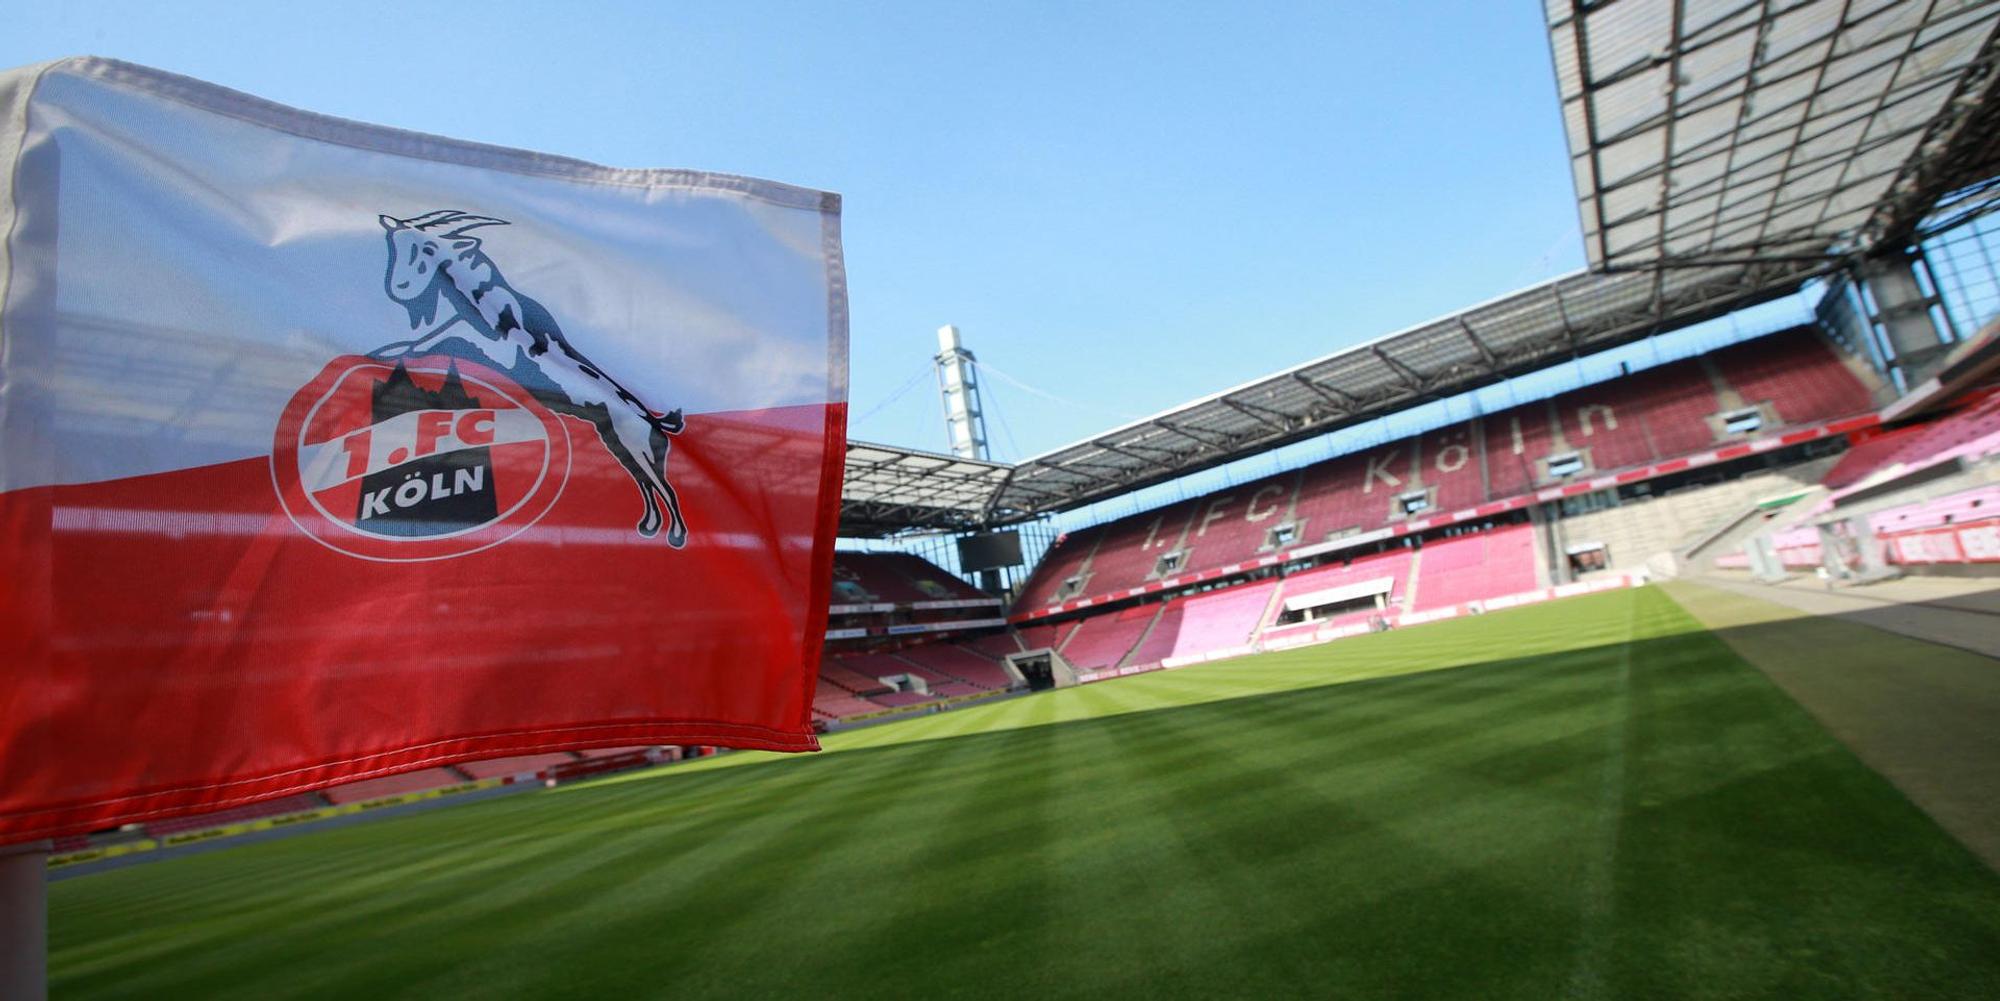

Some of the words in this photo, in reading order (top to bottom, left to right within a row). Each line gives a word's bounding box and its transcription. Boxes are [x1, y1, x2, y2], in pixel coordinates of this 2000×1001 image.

[360, 465, 484, 521] KÖLN
[1198, 484, 1284, 537] FC
[1363, 404, 1619, 494] Köln
